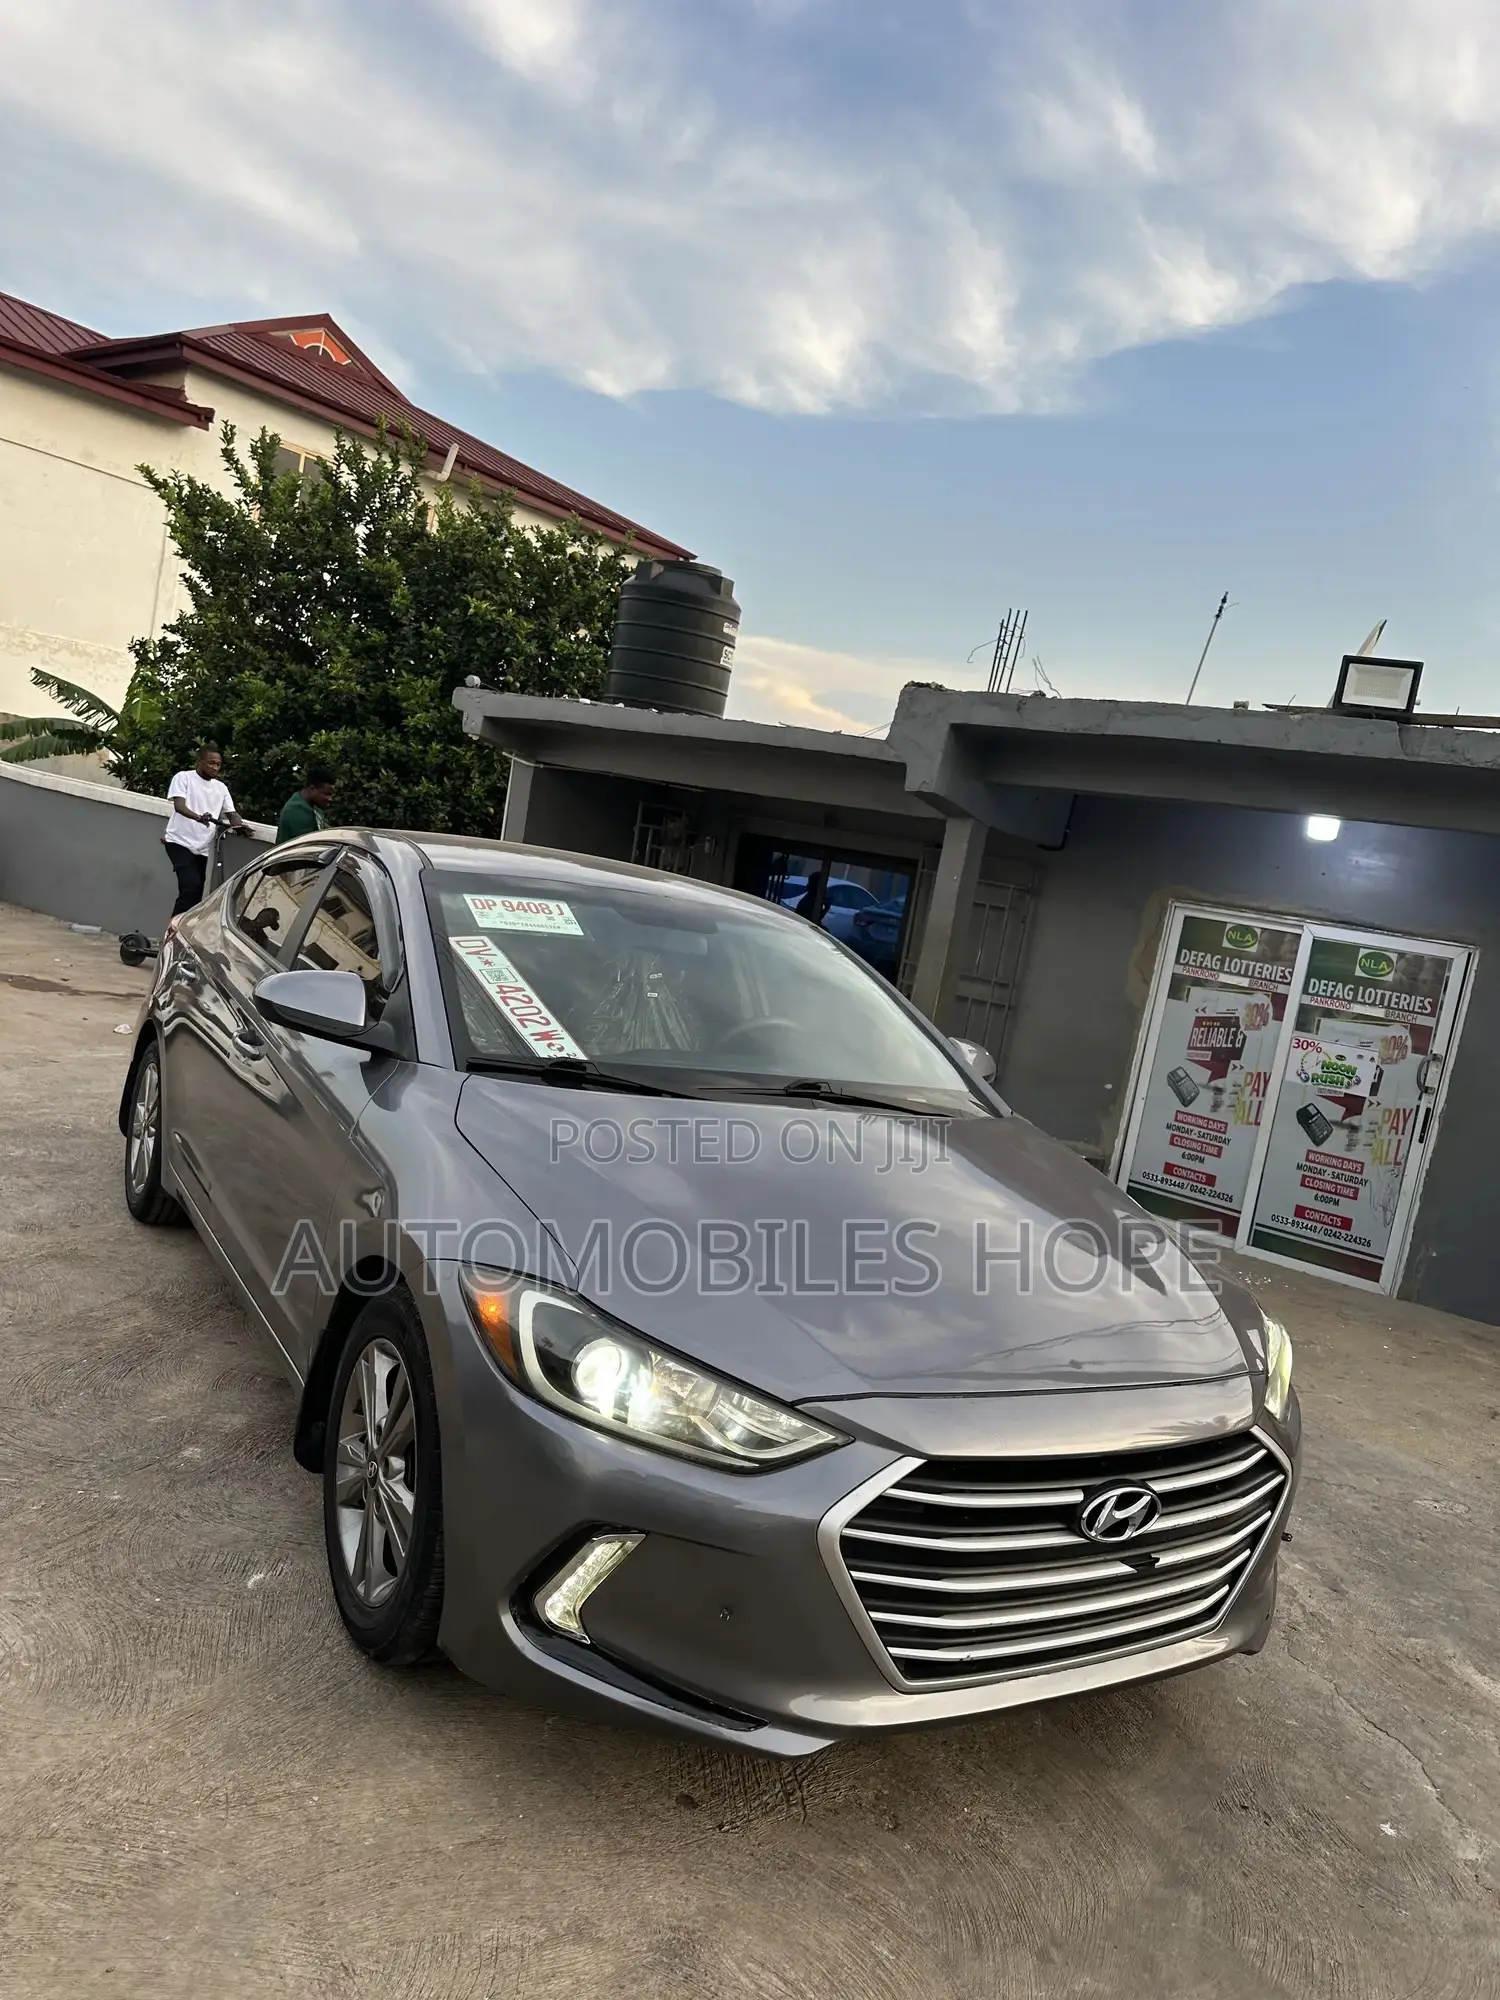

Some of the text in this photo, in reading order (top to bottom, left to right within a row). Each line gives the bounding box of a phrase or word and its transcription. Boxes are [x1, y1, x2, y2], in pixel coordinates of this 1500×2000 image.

[470, 898, 497, 911] DP
[501, 900, 553, 916] 9408
[556, 904, 565, 916] J
[1227, 930, 1254, 943] NLA
[1179, 949, 1293, 983] DEFAG LOTTERIES
[1360, 958, 1389, 971] NLA
[455, 939, 497, 957] DV
[496, 984, 552, 1029] 4202
[1182, 967, 1279, 992] PANKRONO BRANCH
[1308, 977, 1433, 1014] DEFAG LOTTERIES
[1309, 996, 1418, 1023] PANKRONO BRANCH
[1190, 1027, 1244, 1048] RELIABLE &
[1292, 1038, 1323, 1054] 30%
[1320, 1060, 1358, 1077] NOON
[1240, 1071, 1272, 1098] PAY
[1310, 1072, 1346, 1087] RUSH
[1177, 1112, 1226, 1132] WORKING DAYS
[1378, 1108, 1414, 1136] PAY
[1166, 1122, 1193, 1136] MONDAY
[1197, 1130, 1232, 1146] SATURDAY
[1173, 1136, 1219, 1155] CLOSING TIME
[1181, 1151, 1205, 1164] 6:00PM
[1308, 1151, 1362, 1172] WORKING DAYS
[1173, 1166, 1207, 1182] CONTACTS
[1296, 1162, 1327, 1177] MONDAY
[1331, 1171, 1368, 1187] SATURDAY
[1142, 1171, 1185, 1190] 0533-893448
[1189, 1183, 1234, 1203] 0242-224326
[1304, 1177, 1355, 1197] CLOSING TIME
[1314, 1193, 1340, 1207] 6:00PM
[1304, 1209, 1342, 1227] CONTACTS
[1271, 1214, 1318, 1234] 0533-893448
[1323, 1227, 1372, 1248] 0242-224326
